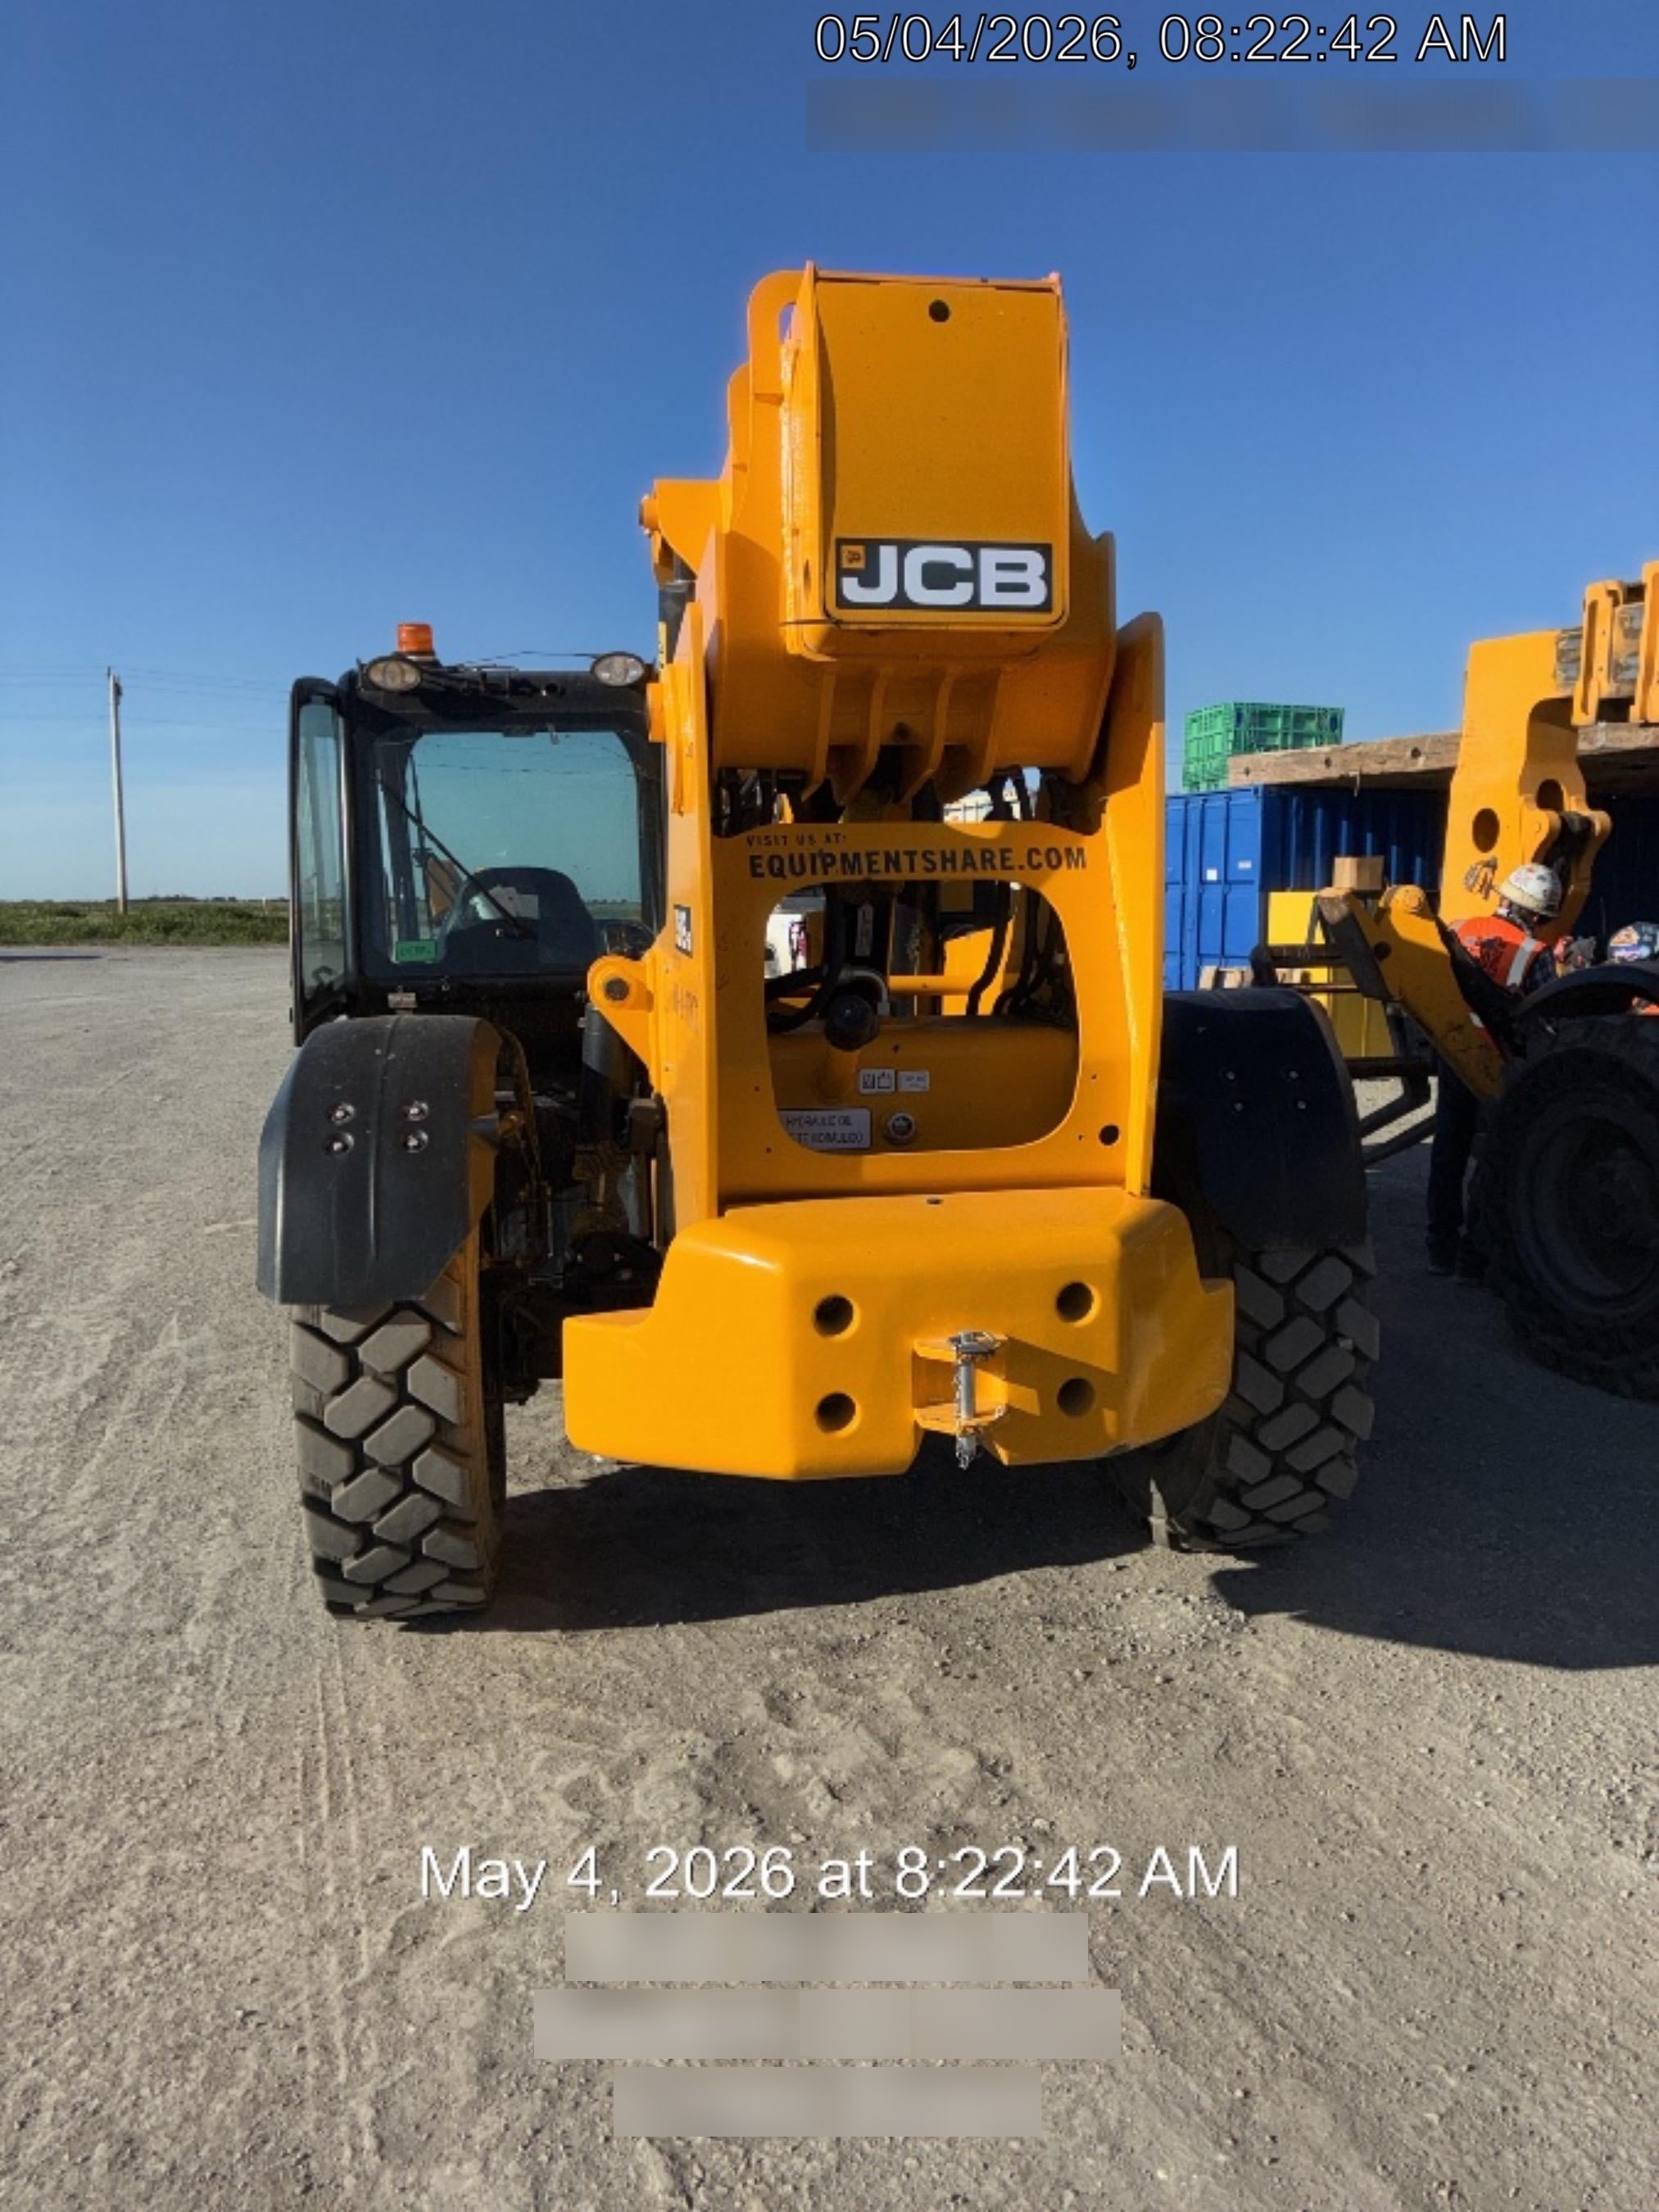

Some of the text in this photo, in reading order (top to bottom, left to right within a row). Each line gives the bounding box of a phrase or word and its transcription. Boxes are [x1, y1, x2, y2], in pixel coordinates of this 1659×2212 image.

[841, 544, 1049, 606] JCB
[746, 835, 788, 847] VISIT
[796, 833, 816, 846] US
[749, 846, 1087, 879] EQUIPMENTSHARE.COM
